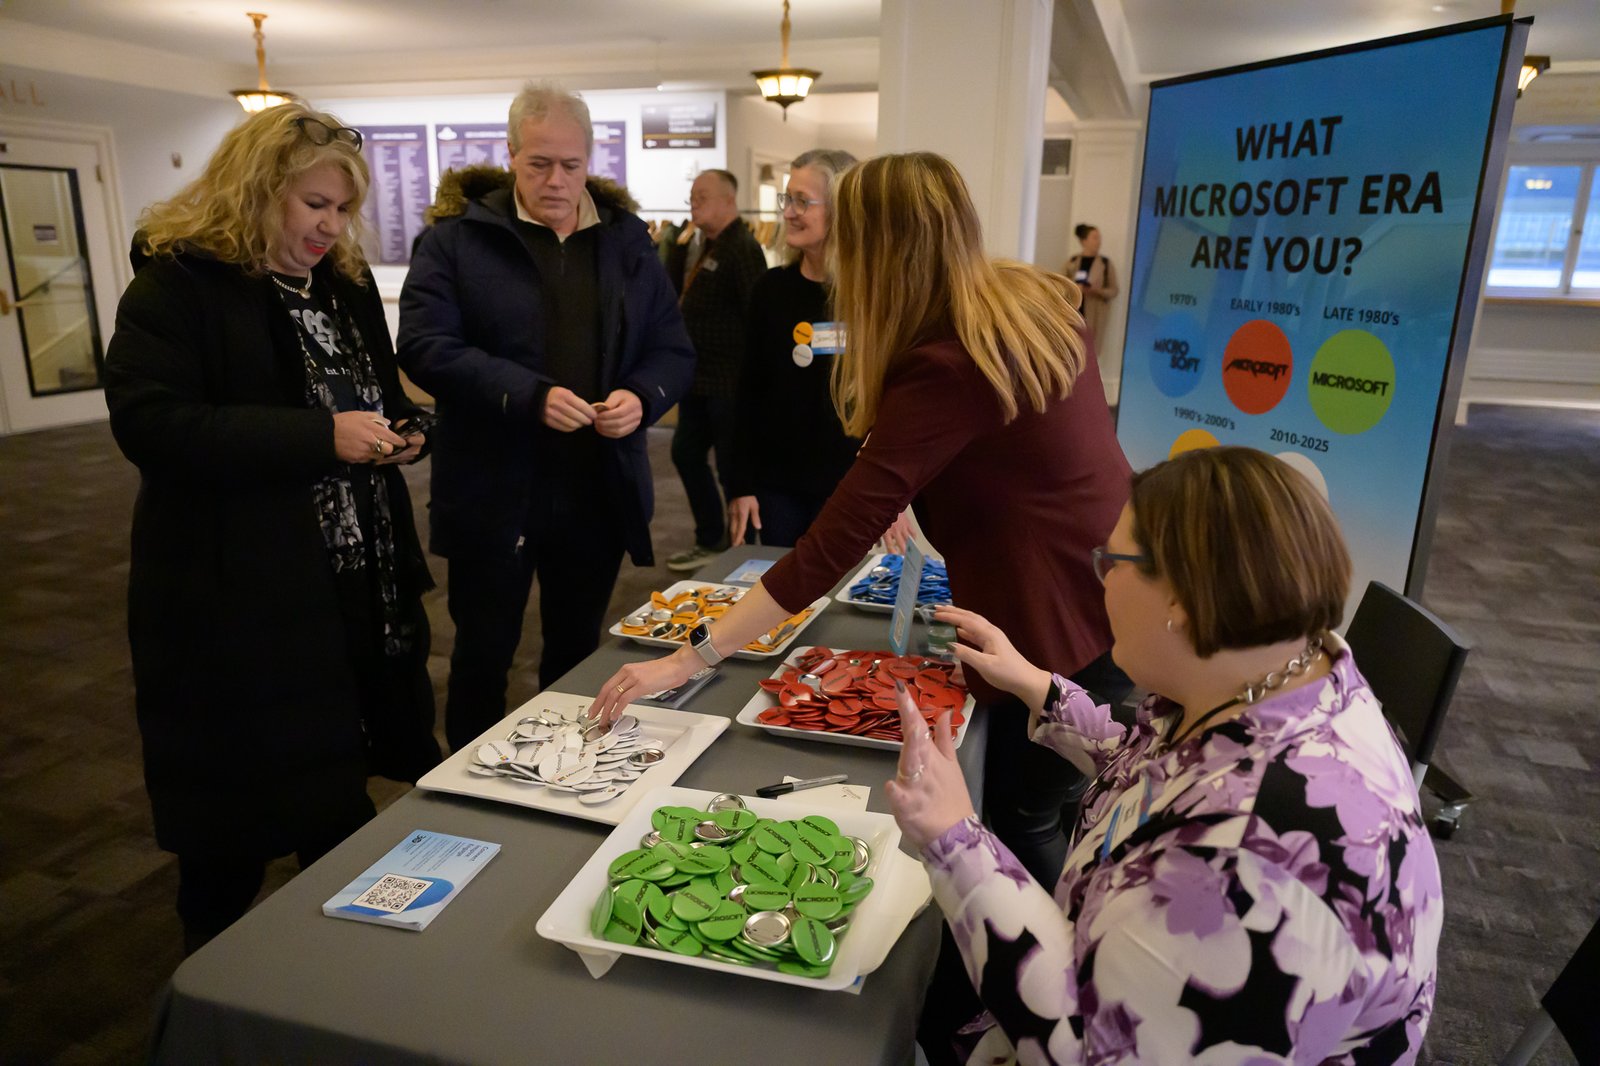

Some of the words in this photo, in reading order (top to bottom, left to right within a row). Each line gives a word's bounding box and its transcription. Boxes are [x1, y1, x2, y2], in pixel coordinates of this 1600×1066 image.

[1235, 116, 1343, 162] WHAT
[1153, 176, 1349, 218] MICROSOFT
[1358, 171, 1444, 215] ERA
[1190, 235, 1252, 270] ARE
[1263, 236, 1363, 276] YOU?
[1169, 293, 1197, 306] 1970's
[1230, 298, 1264, 312] EARLY
[1267, 302, 1300, 316] 1980's
[1323, 306, 1354, 322] LATE
[1358, 309, 1400, 326] 1980's
[1312, 371, 1389, 396] MICROSOFT
[1269, 428, 1329, 453] 2010-2025
